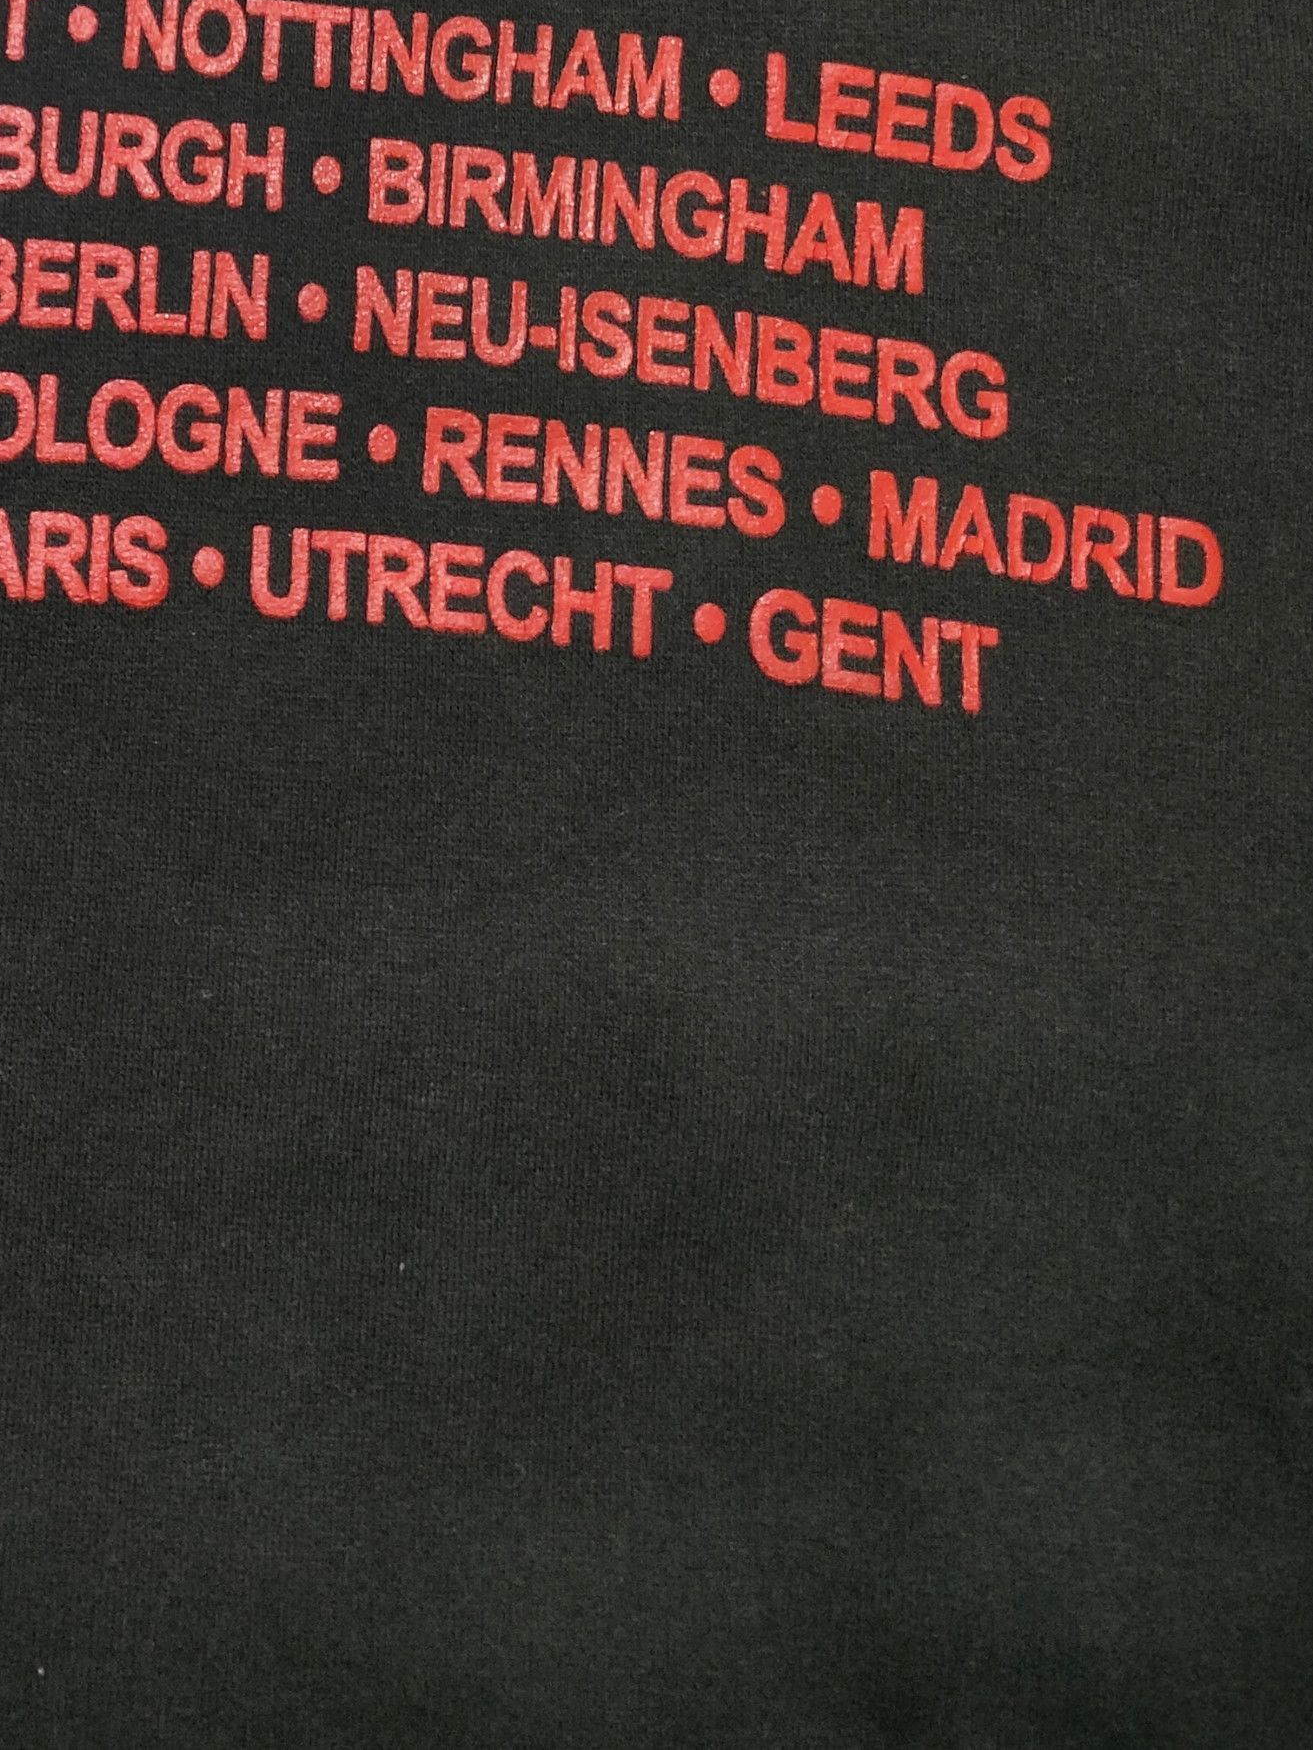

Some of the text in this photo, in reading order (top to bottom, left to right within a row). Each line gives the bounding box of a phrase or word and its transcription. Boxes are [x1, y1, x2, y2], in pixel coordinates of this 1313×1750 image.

[762, 49, 1055, 185] LEEDS
[366, 135, 927, 297] BIRMINGHAM
[350, 263, 1011, 442] NEU-ISENBERG
[420, 404, 789, 540] RENNES
[866, 467, 1226, 610] MADRID
[247, 522, 675, 661] UTRECHT
[746, 585, 1002, 716] GENT
